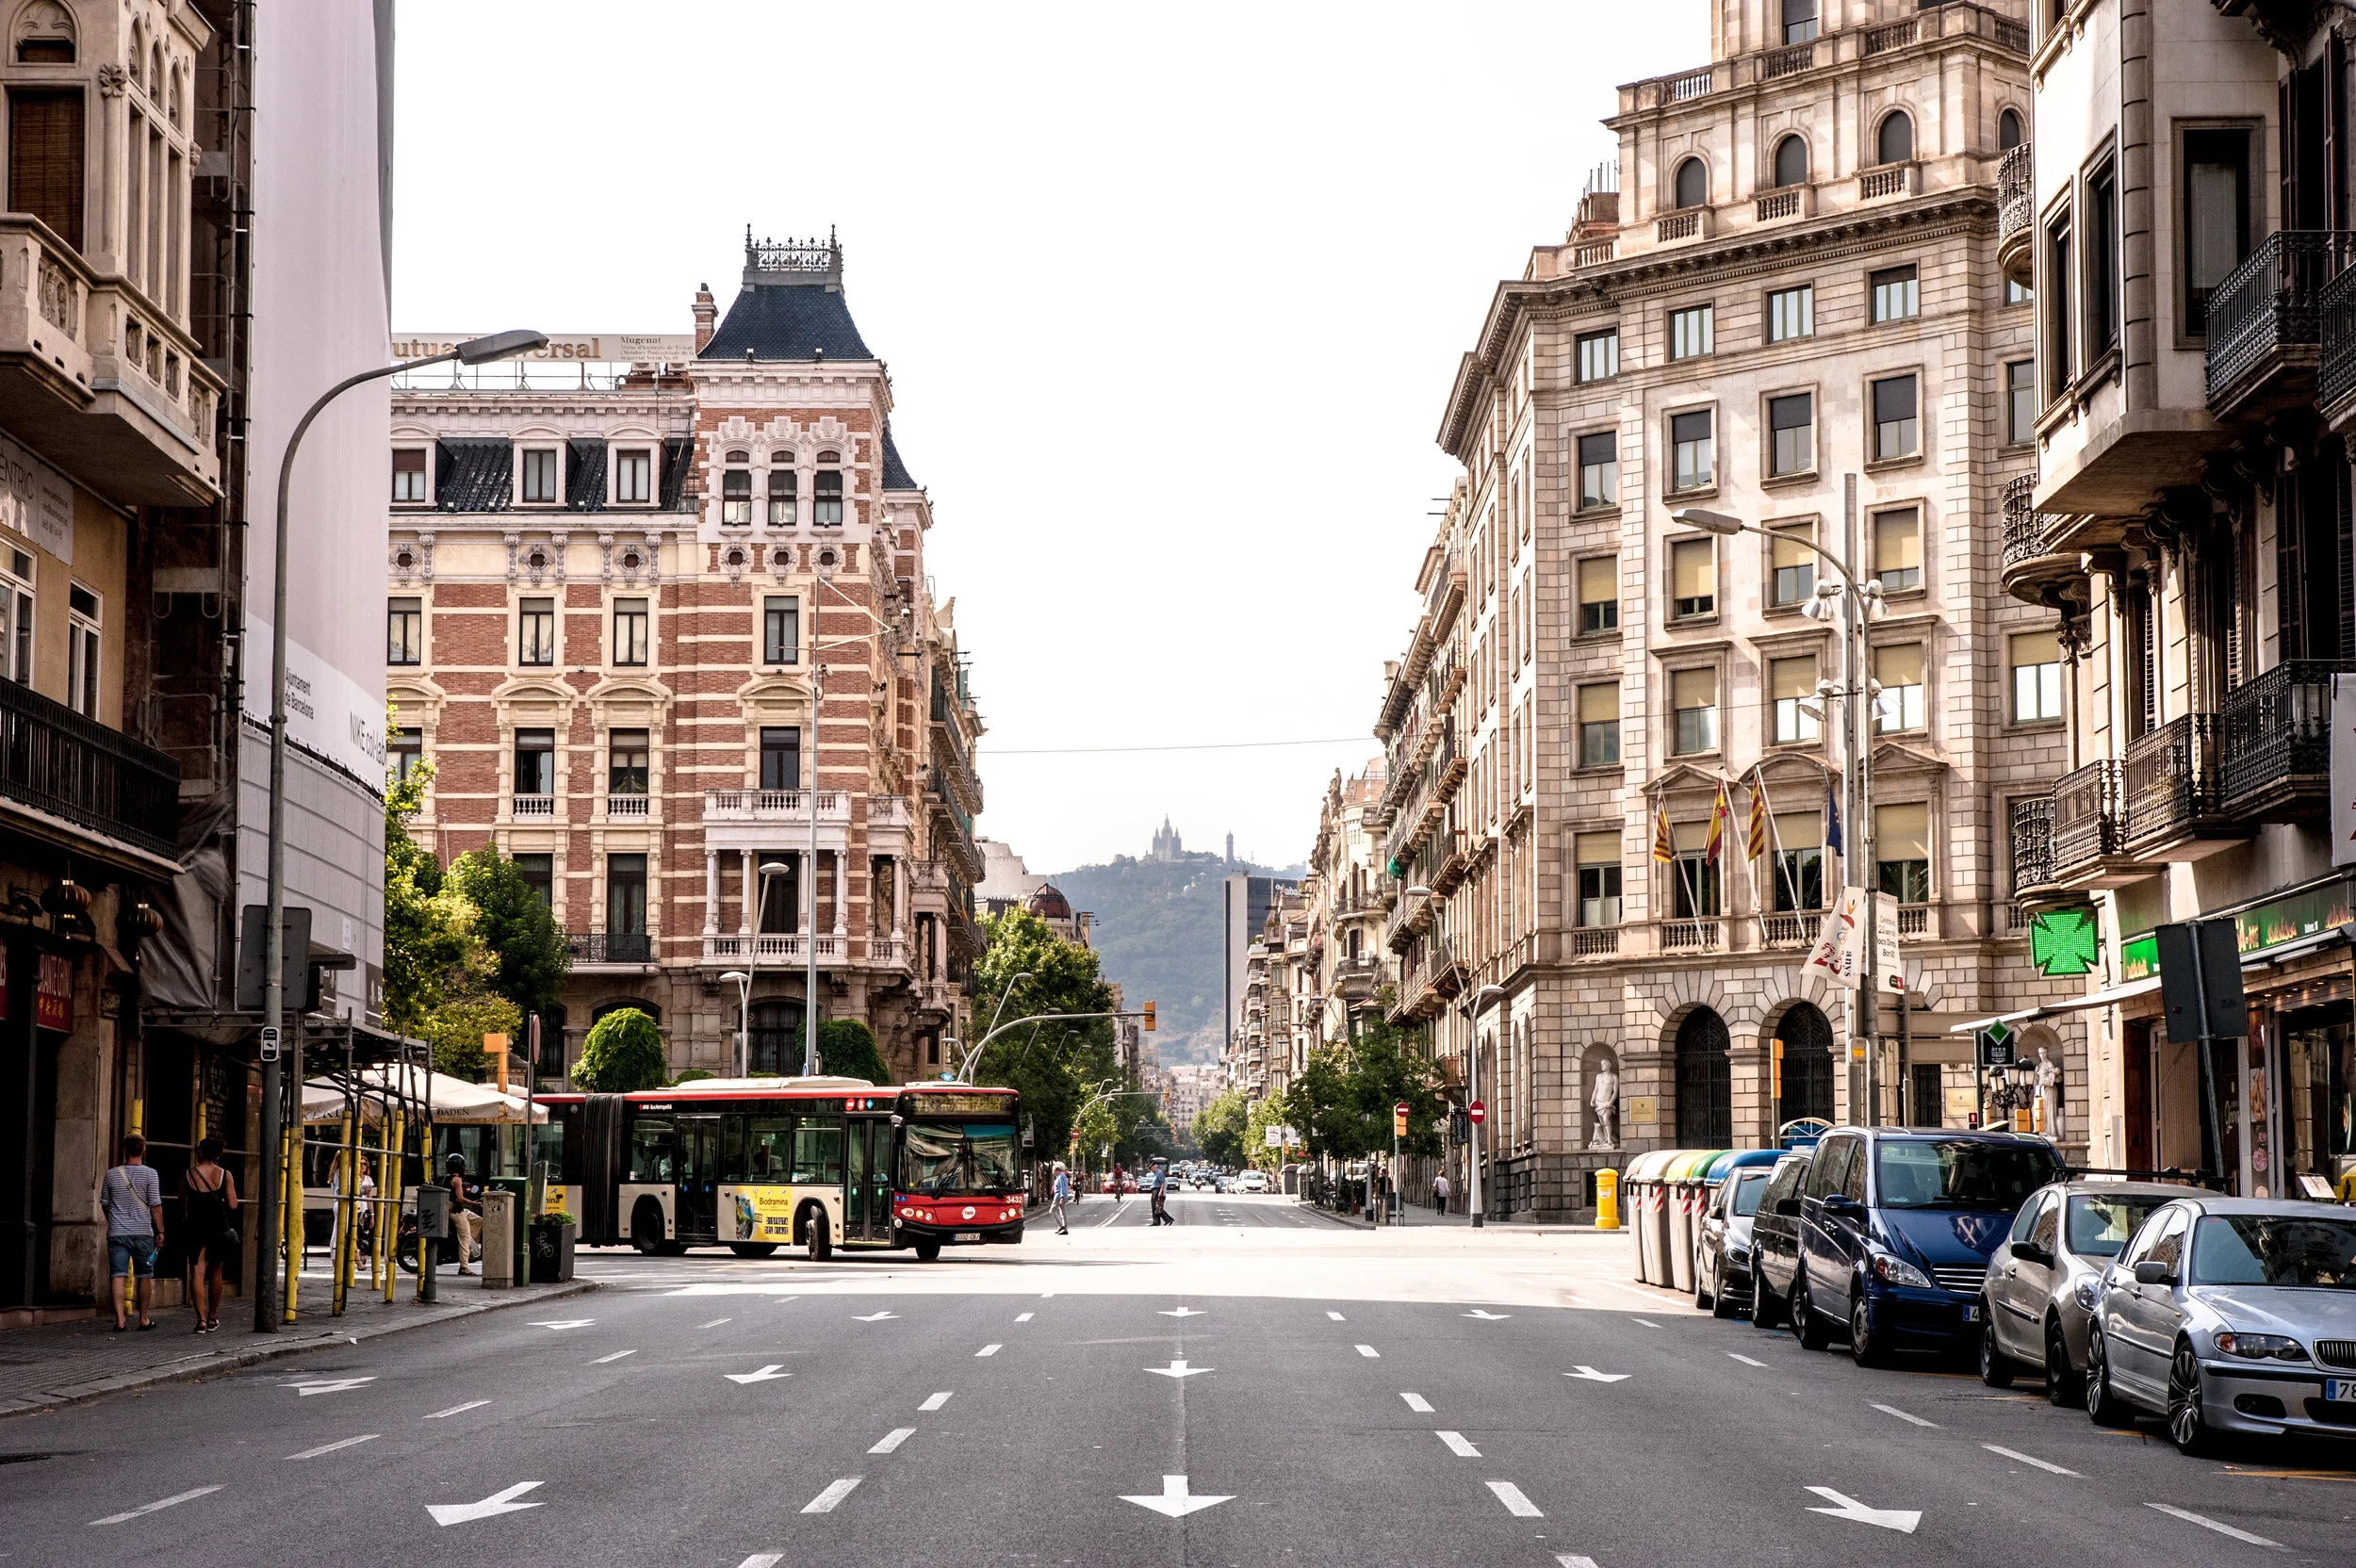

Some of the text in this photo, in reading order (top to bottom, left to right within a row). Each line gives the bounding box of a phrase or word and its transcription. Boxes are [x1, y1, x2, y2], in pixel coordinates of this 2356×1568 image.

[286, 667, 311, 697] Ajuntament
[291, 692, 314, 720] Barcelona
[350, 710, 366, 752] NIKE
[1844, 950, 1853, 978] anys
[759, 1197, 789, 1206] Biodramina
[1006, 1195, 1023, 1204] 3432
[764, 1226, 789, 1234] DEL VIAJE
[766, 1217, 789, 1225] DISFRUTA
